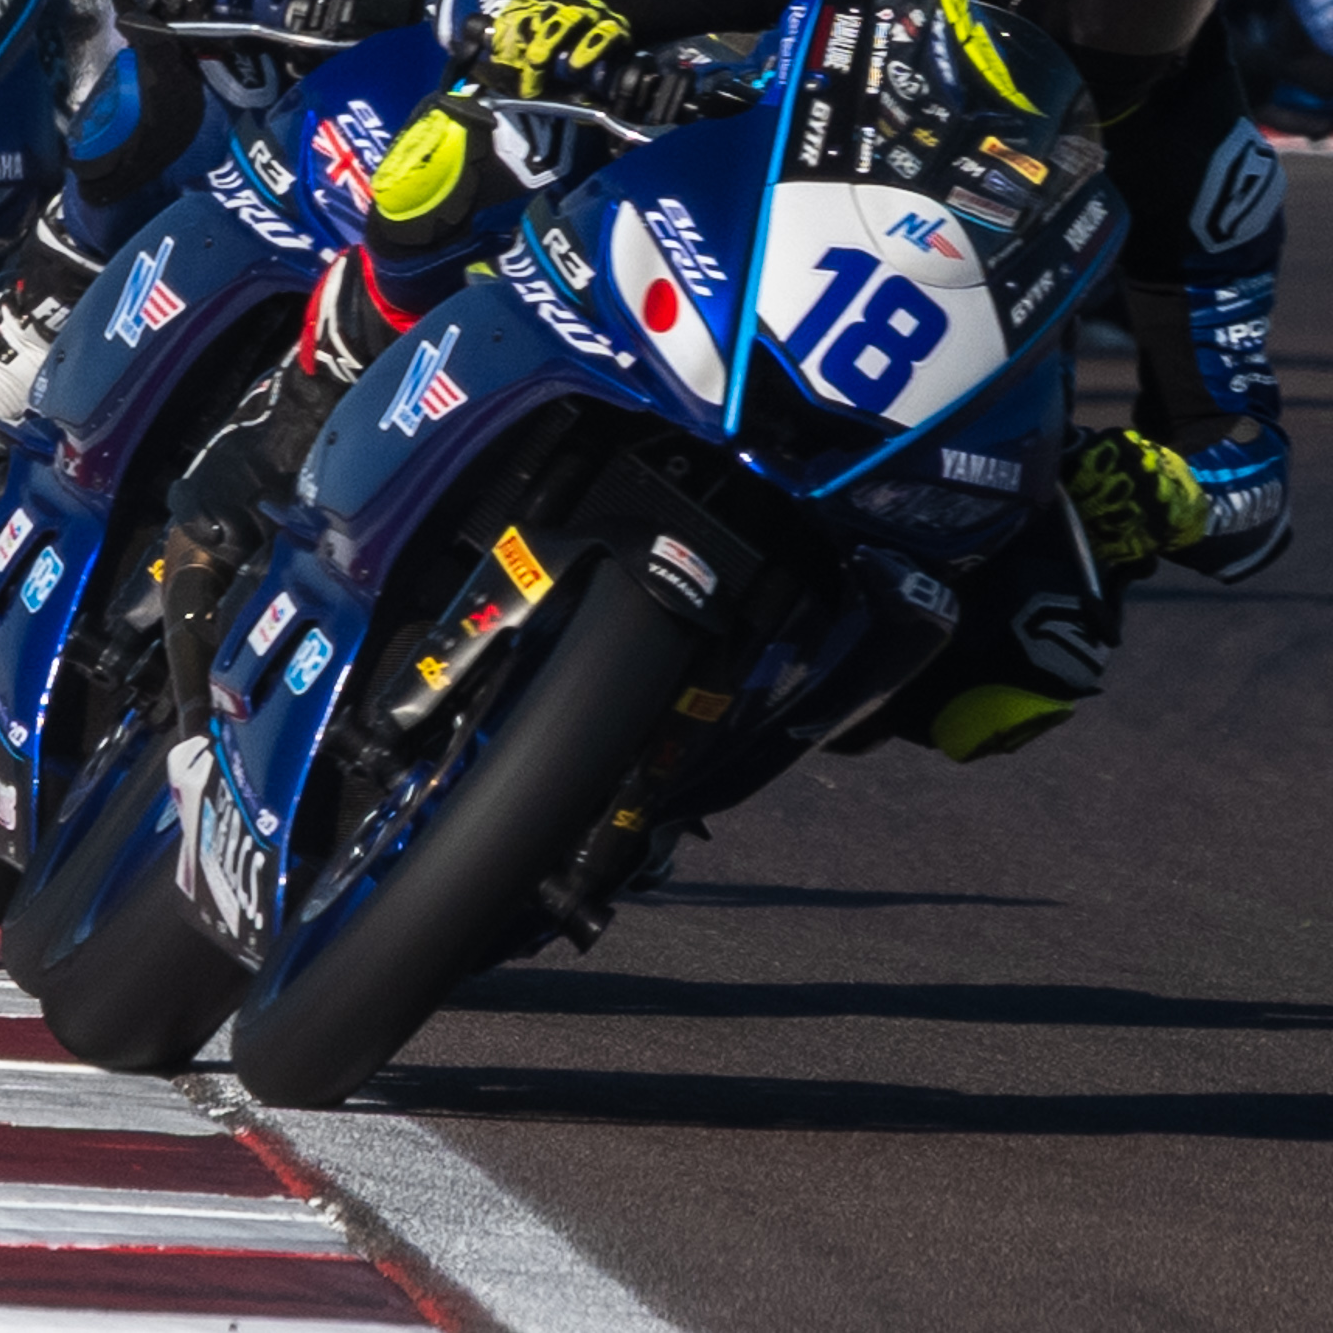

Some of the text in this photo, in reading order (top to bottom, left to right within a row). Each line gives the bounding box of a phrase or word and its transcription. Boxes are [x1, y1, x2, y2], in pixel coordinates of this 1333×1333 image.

[248, 139, 297, 196] R3
[541, 227, 597, 291] R3
[644, 209, 714, 298] CRU
[656, 197, 730, 282] BLU
[783, 246, 950, 416] 18
[647, 562, 705, 609] YAMAHA
